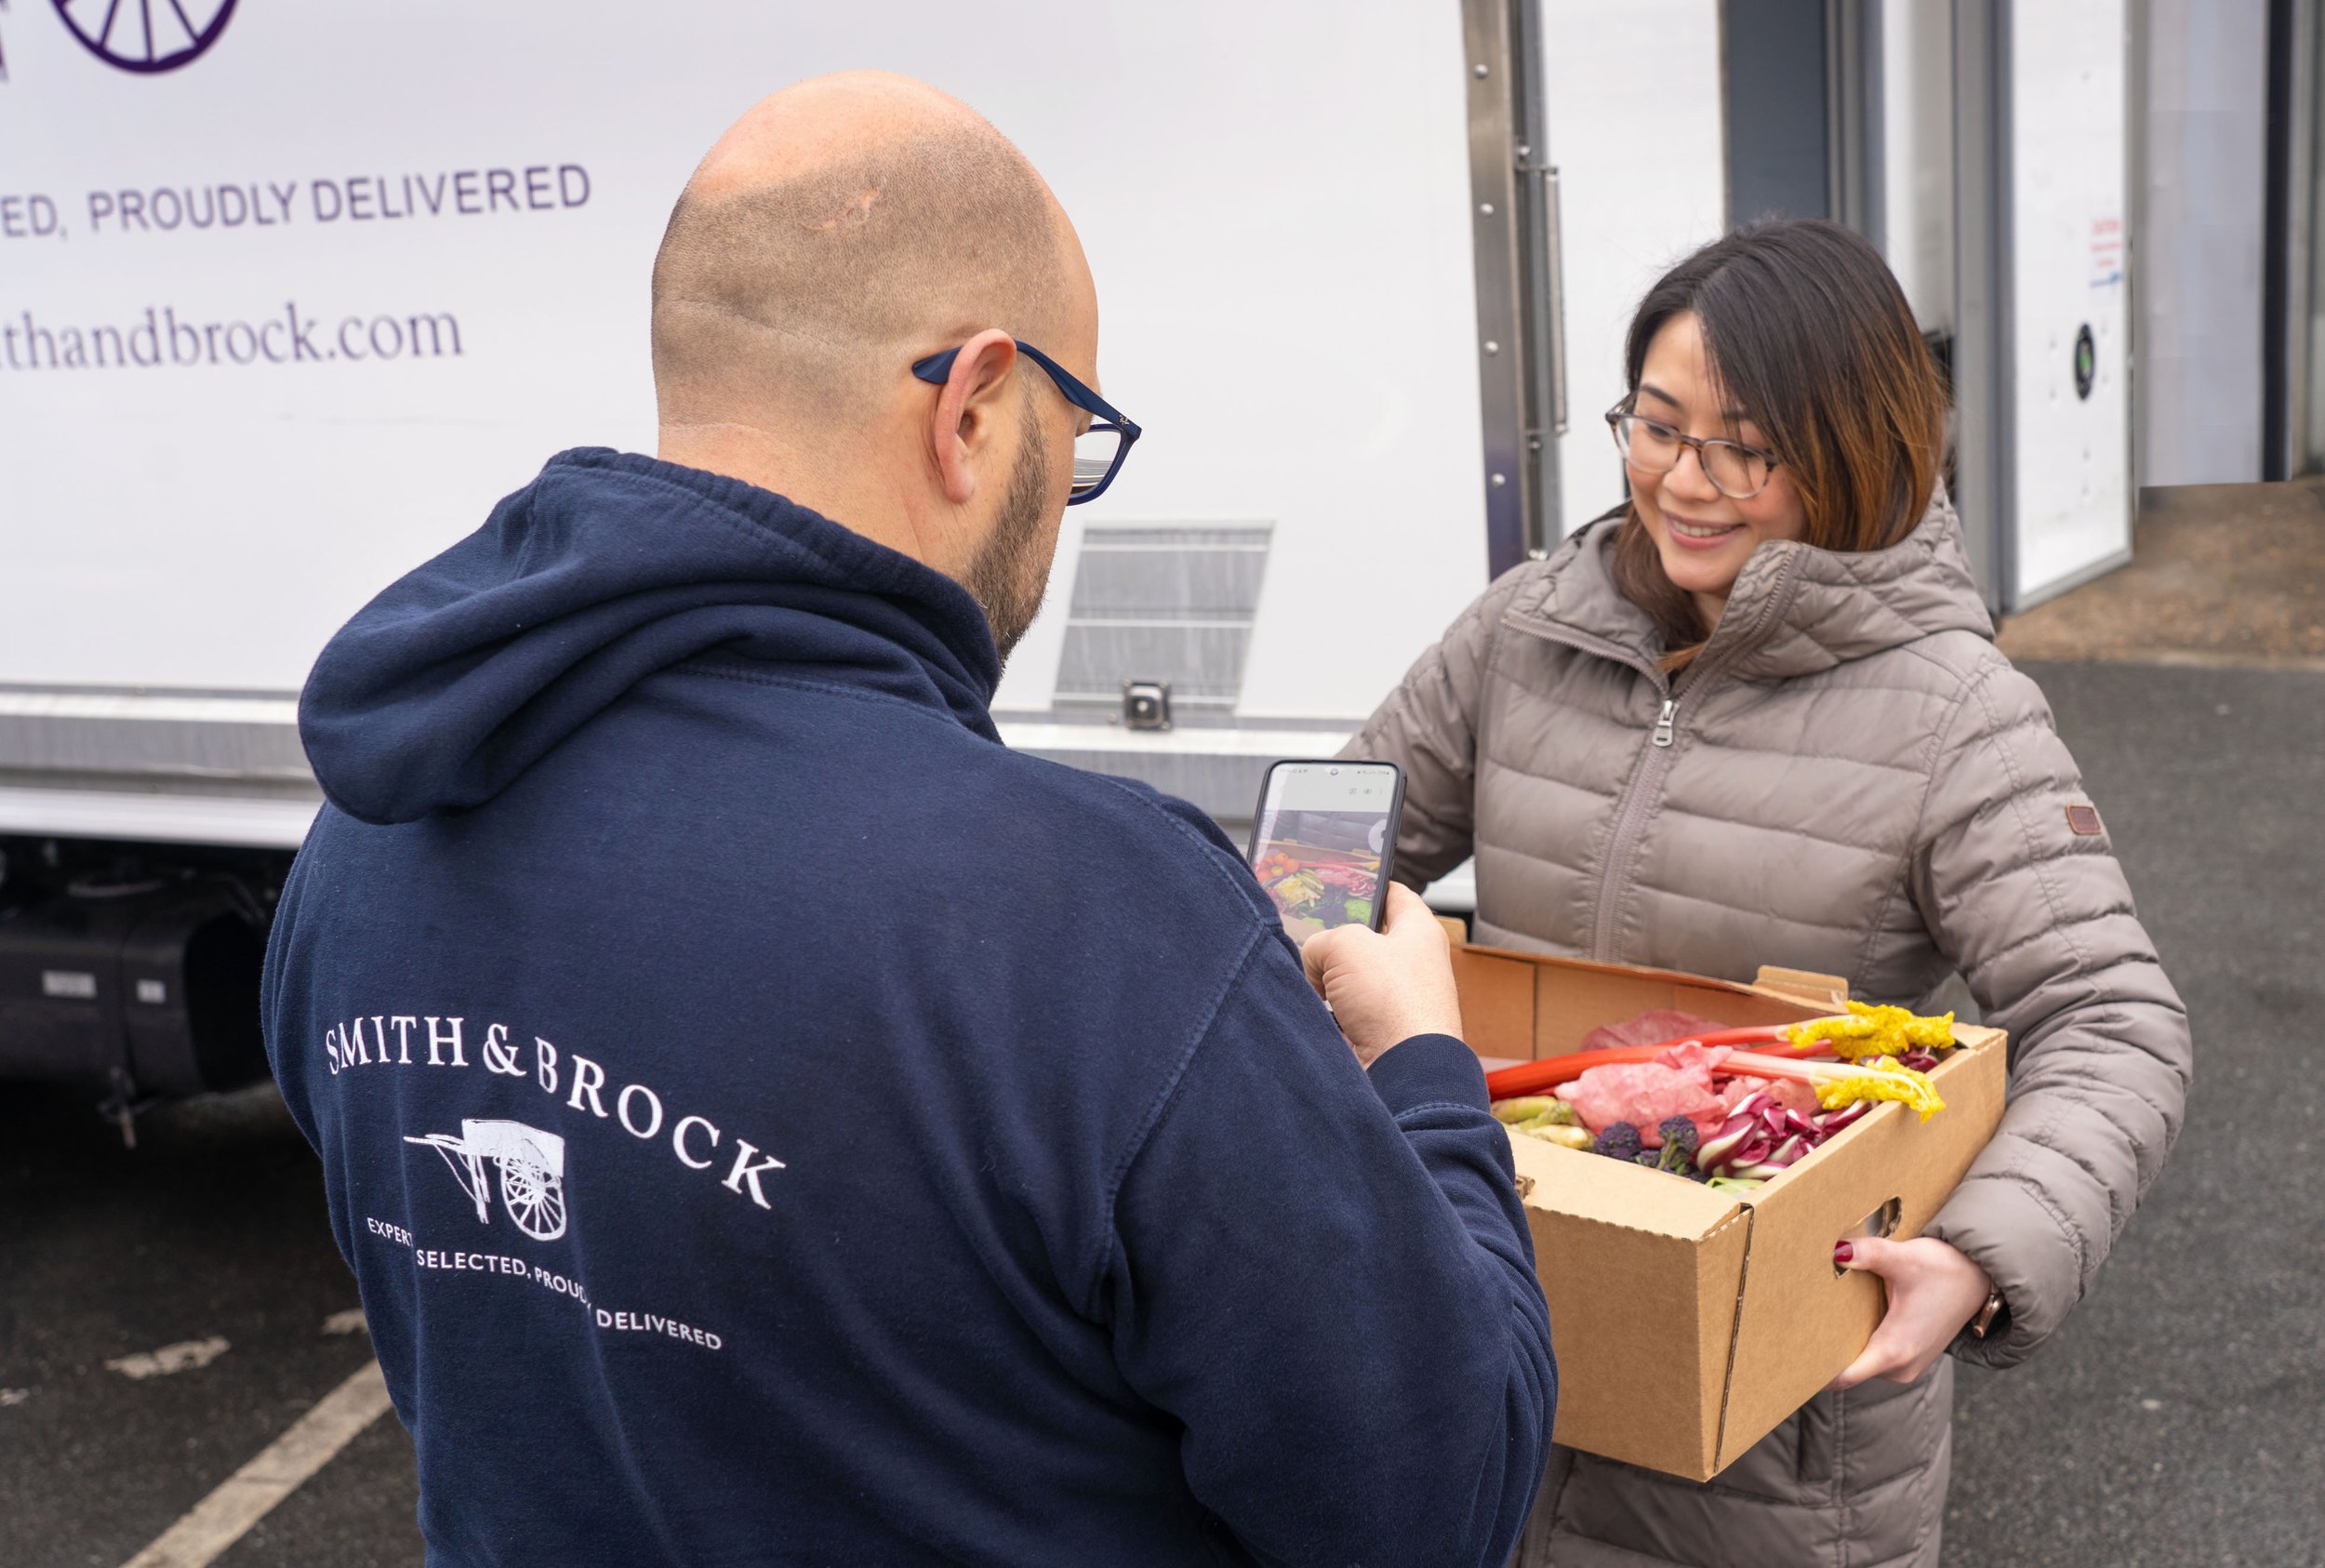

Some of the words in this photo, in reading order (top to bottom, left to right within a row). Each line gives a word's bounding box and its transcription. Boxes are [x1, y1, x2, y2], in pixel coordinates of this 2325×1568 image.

[0, 194, 68, 241] ED,
[88, 183, 297, 232] PROUDLY
[312, 164, 591, 223] DELIVERED
[0, 301, 465, 370] thandbrock.com
[326, 1016, 469, 1075] SMITH
[483, 1023, 527, 1077] &
[535, 1036, 787, 1210] BROCK
[417, 1249, 531, 1280] SELECTED,
[596, 1309, 722, 1350] DELIVERED
